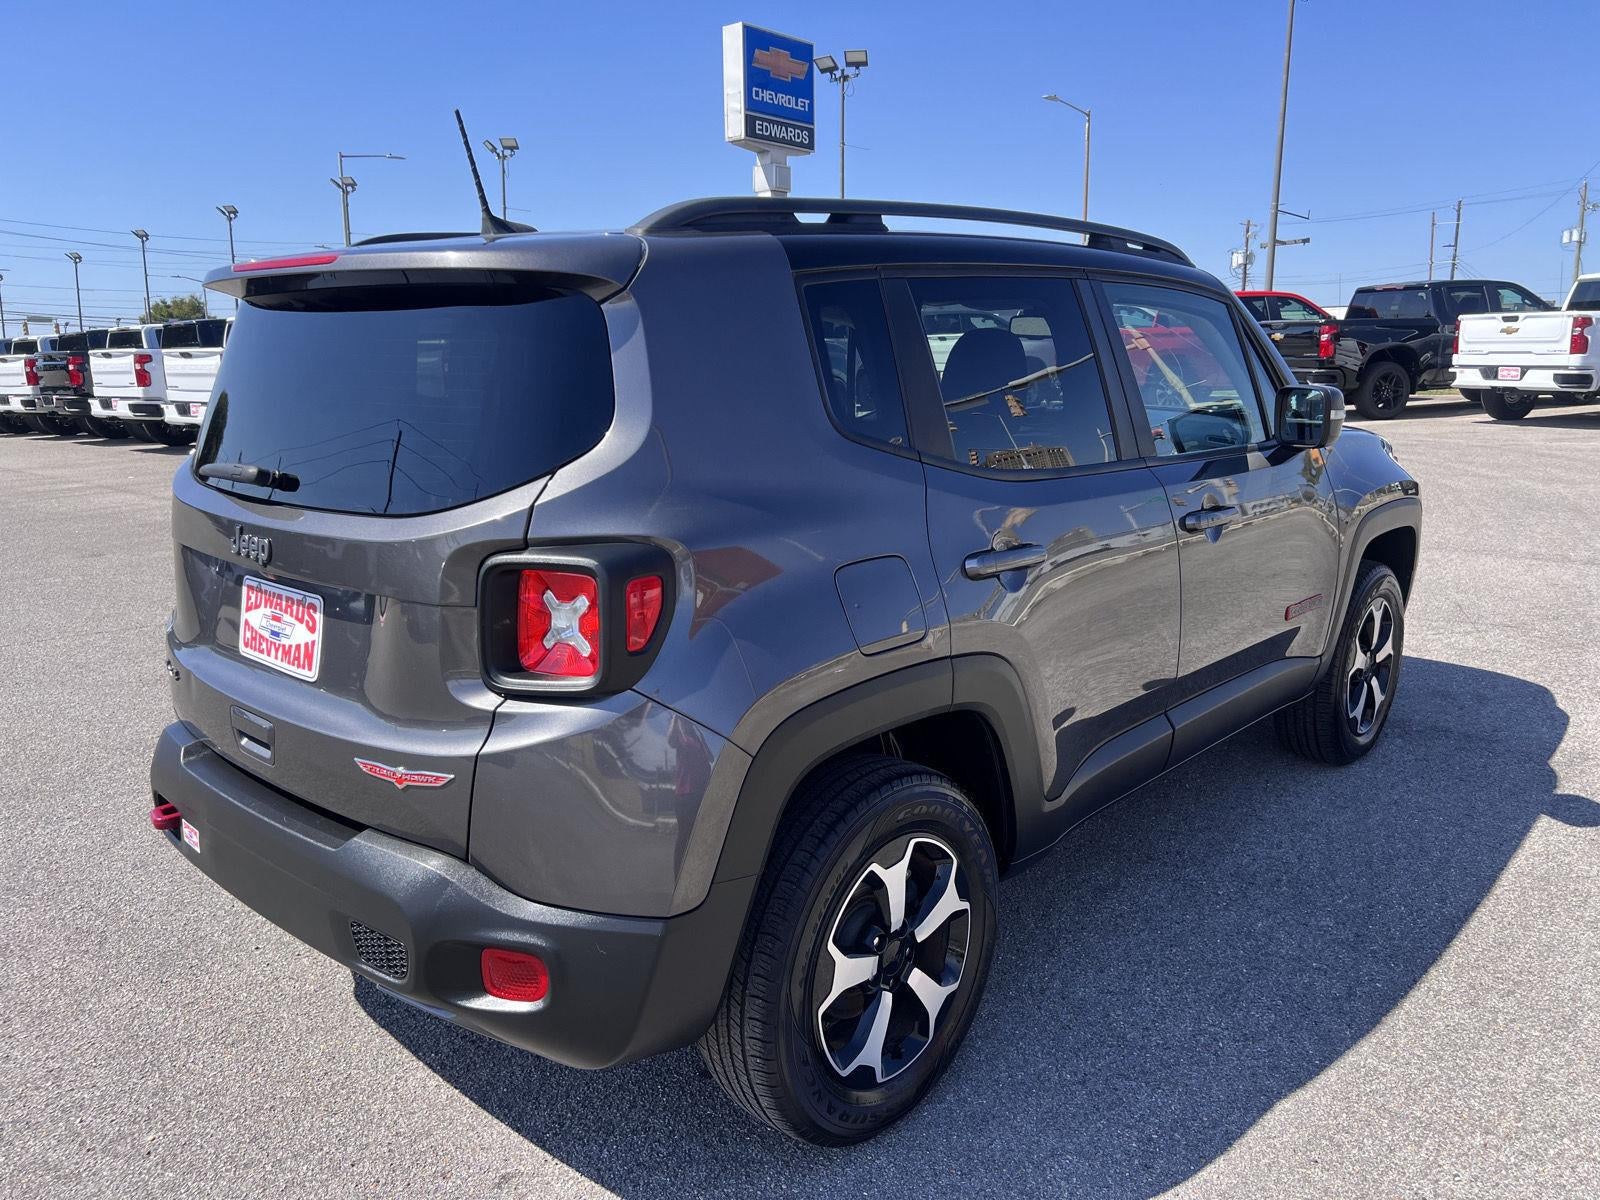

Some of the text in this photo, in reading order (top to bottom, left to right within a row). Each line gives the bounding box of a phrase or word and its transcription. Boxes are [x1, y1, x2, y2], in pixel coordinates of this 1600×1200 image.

[752, 87, 809, 112] CHEVROLET
[755, 120, 809, 144] EDWARDS
[230, 524, 272, 567] Jeep
[245, 584, 318, 635] EDWARDS
[243, 617, 316, 672] CHEVYMAN
